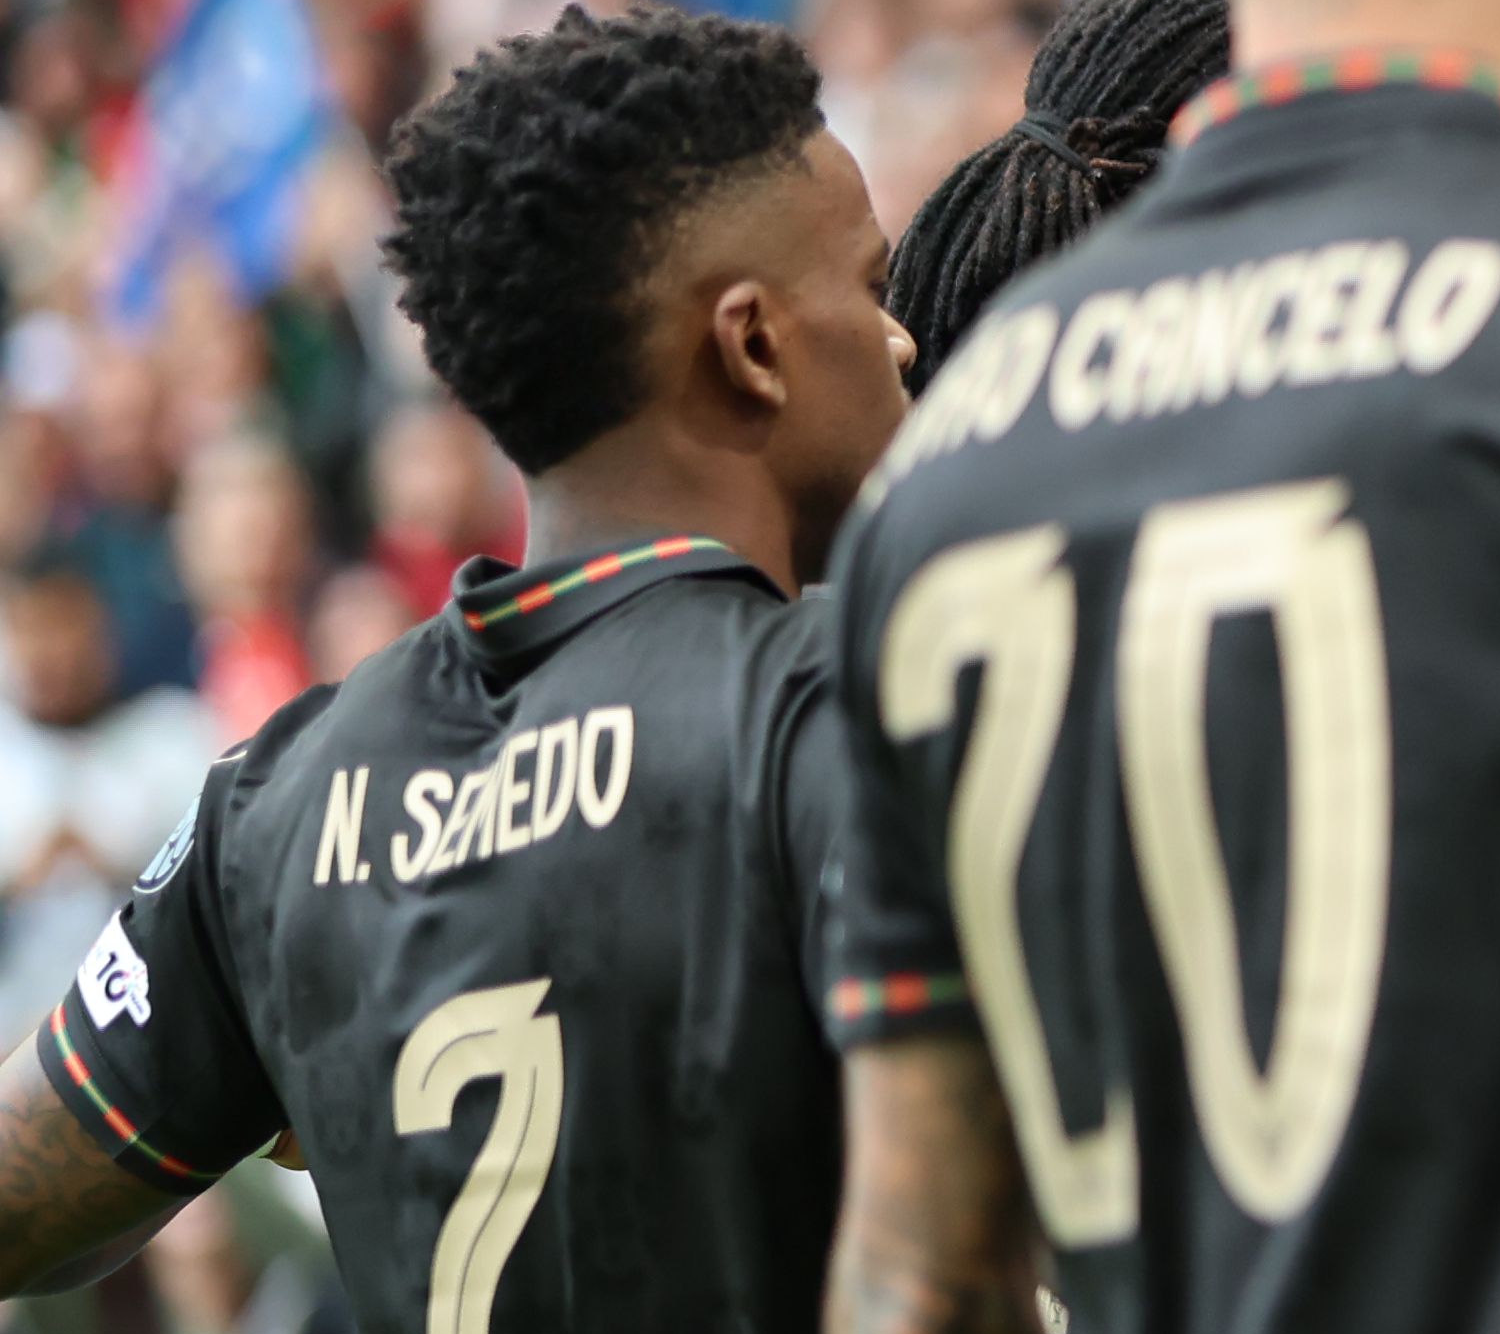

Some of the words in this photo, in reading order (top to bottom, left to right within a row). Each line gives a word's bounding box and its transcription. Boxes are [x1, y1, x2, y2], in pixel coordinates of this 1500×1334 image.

[313, 765, 371, 886] N.
[390, 703, 635, 884] SEMEDO
[879, 476, 1392, 1250] 20
